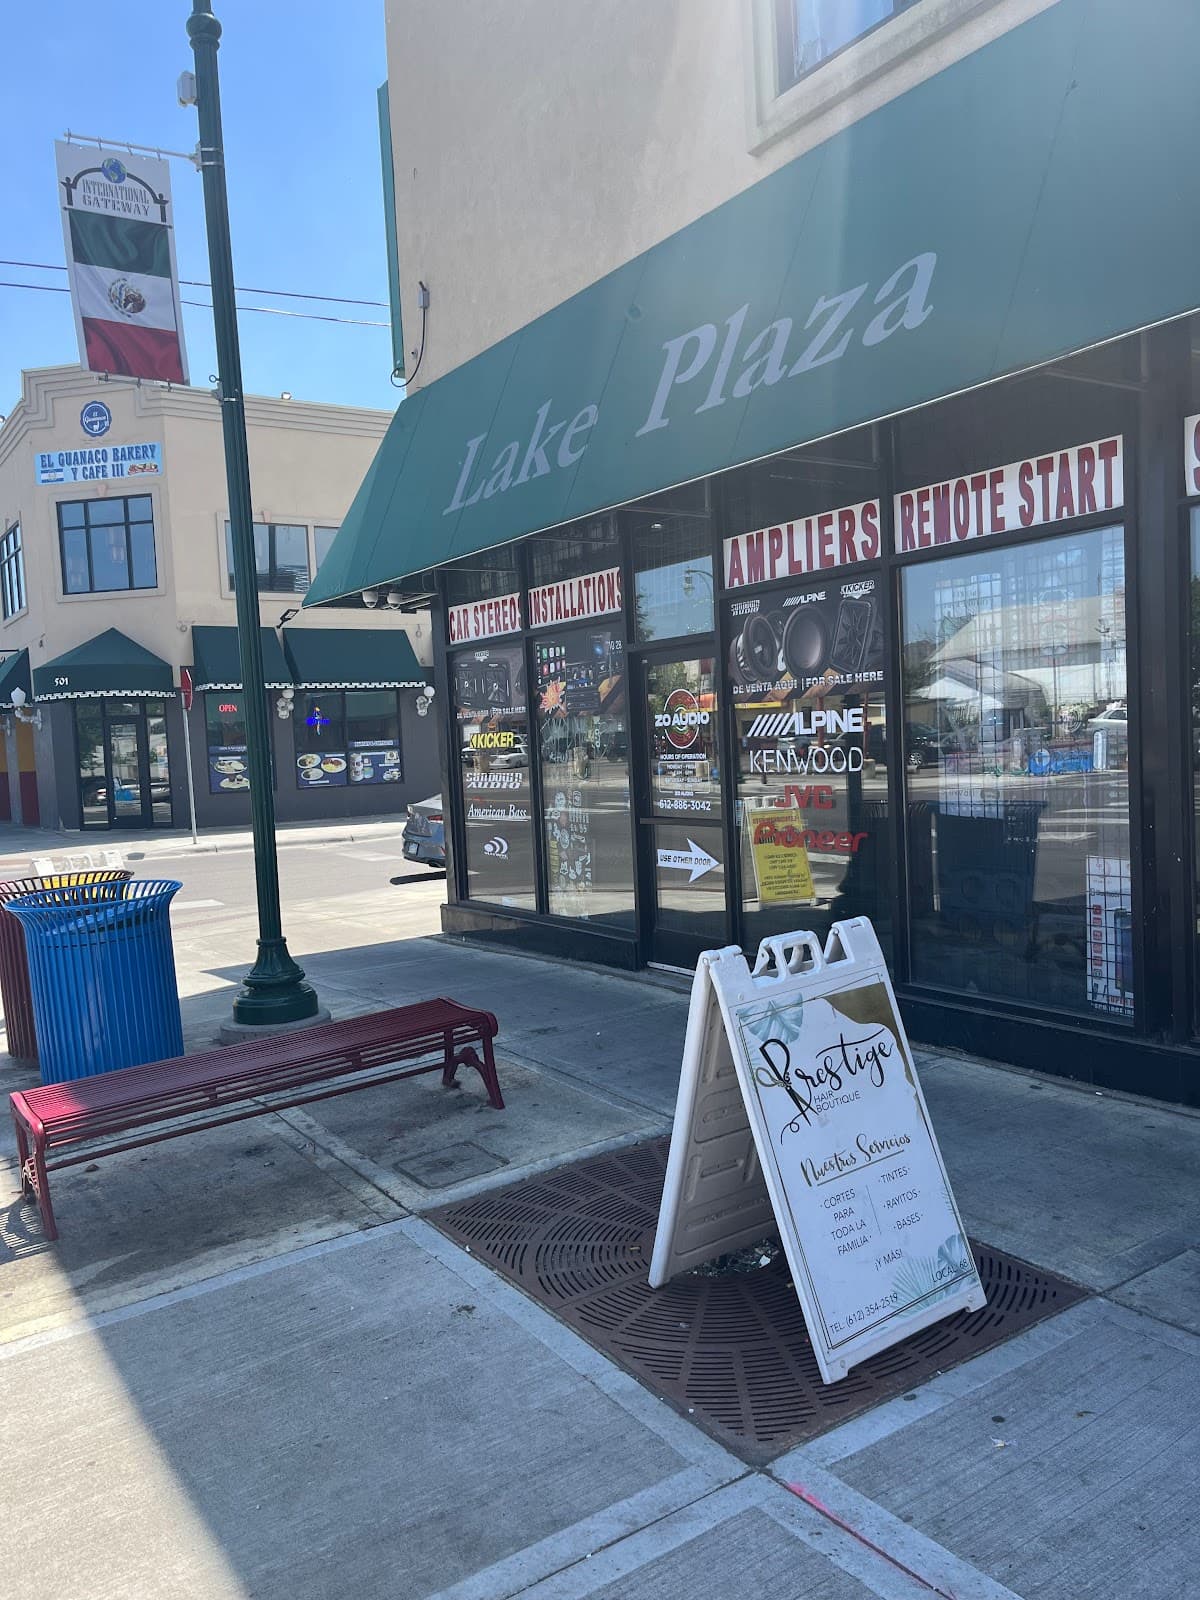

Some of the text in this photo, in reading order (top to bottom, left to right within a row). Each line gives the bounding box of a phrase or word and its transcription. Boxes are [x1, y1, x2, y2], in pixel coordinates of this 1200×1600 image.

[82, 179, 150, 204] INTERNATIONAL
[82, 194, 150, 216] GATEWAY
[442, 250, 937, 517] Lake Plaza
[40, 444, 157, 469] EL GUANACO BAKERY
[71, 463, 125, 481] Y CAFE III
[901, 469, 1005, 552] REMOTE
[1017, 440, 1119, 527] START
[728, 501, 880, 588] AMPLIERS
[449, 608, 471, 642] CAR
[54, 677, 69, 687] 501
[733, 685, 744, 694] DE
[746, 682, 773, 694] VENTA
[805, 677, 825, 688] FOR
[827, 674, 852, 685] SALE
[854, 671, 884, 682] HERE
[218, 704, 238, 712] OPEN
[672, 711, 710, 726] AUDIO
[778, 708, 864, 736] ALPINE
[475, 731, 516, 749] KICKER
[750, 747, 864, 775] KENWOOD
[774, 785, 833, 810] JVC
[467, 803, 527, 818] American Bass
[753, 822, 868, 852] Pioneer
[672, 856, 692, 865] OTHER
[694, 857, 711, 866] DOOR
[758, 1028, 895, 1140] Prestige
[813, 1090, 835, 1104] HAIR
[815, 1091, 861, 1114] BOUTIQUE
[800, 1133, 911, 1187] Nuestros Servicios
[833, 1207, 855, 1223] PARA
[831, 1219, 867, 1241] TODA LA
[845, 1309, 865, 1328] (612)
[865, 1292, 898, 1317] 354-2519
